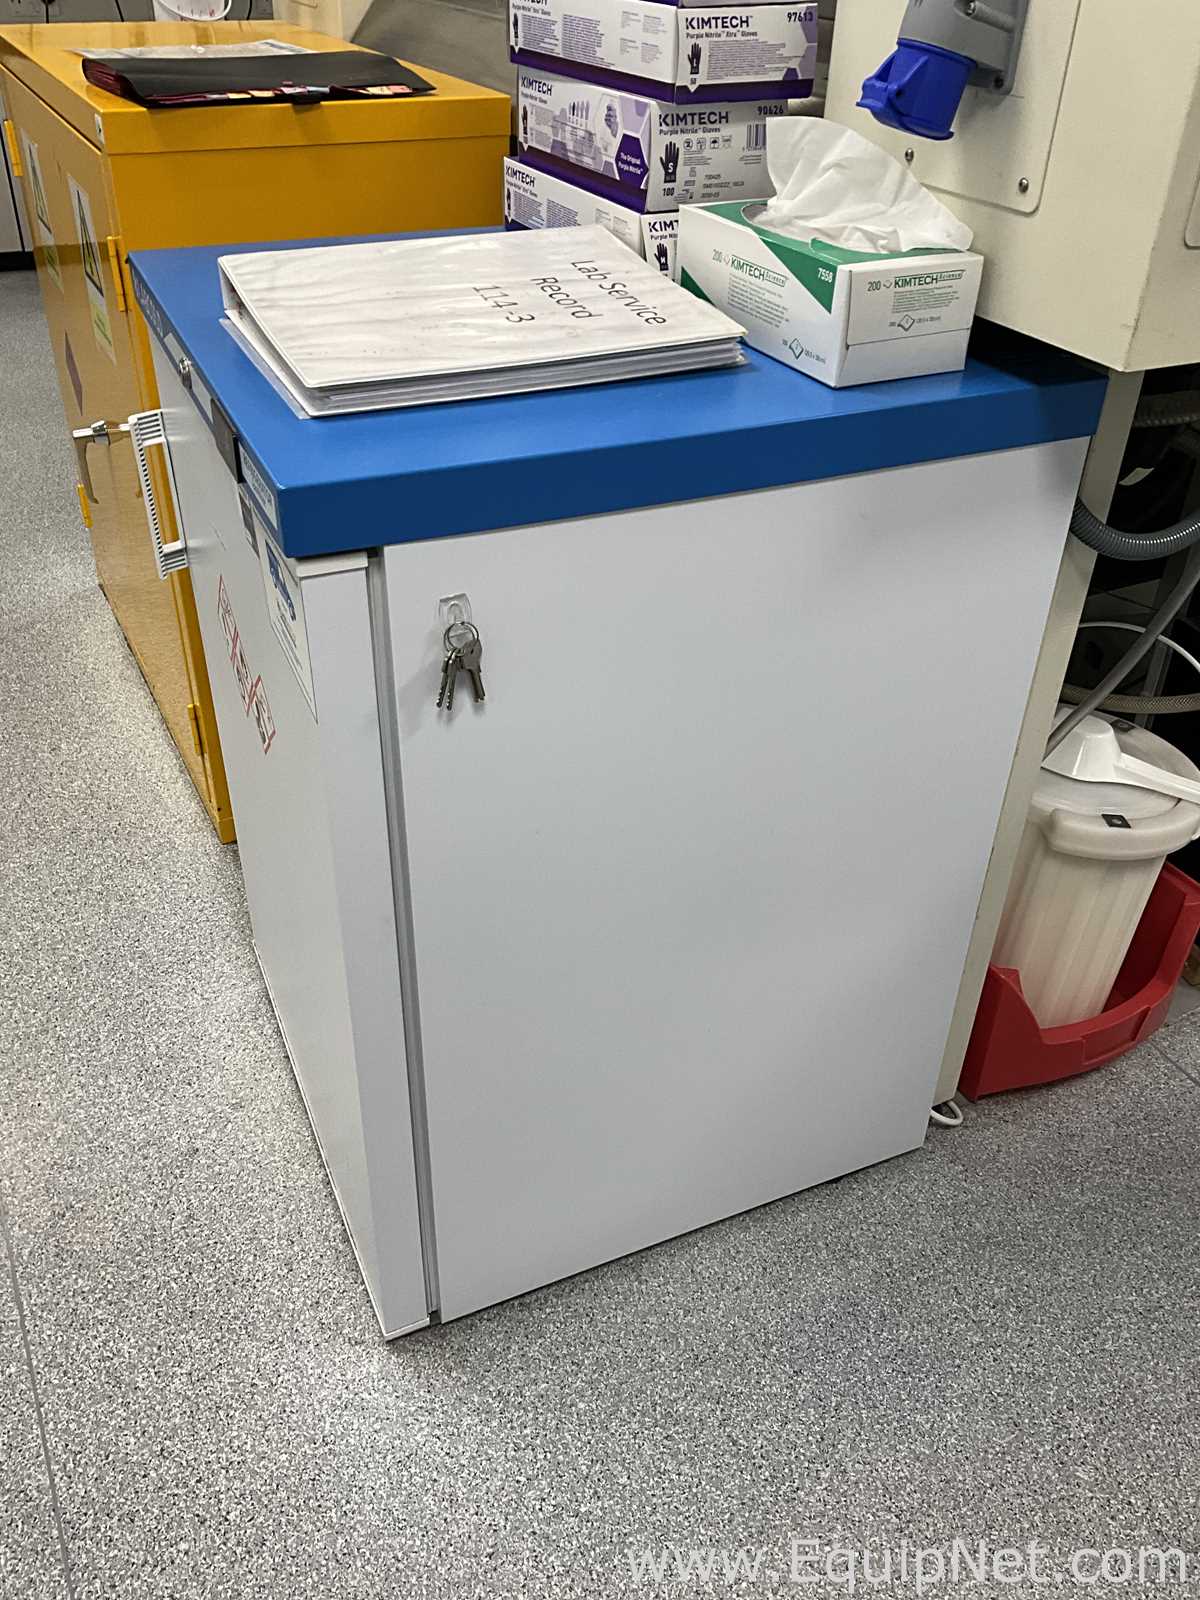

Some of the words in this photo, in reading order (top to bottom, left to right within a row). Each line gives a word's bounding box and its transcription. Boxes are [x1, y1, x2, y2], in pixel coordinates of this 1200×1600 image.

[686, 15, 750, 30] KIMTECH
[521, 76, 553, 96] KIMTECH
[659, 111, 729, 127] KIMTECH
[668, 162, 674, 173] S
[505, 166, 536, 187] KIMTECH
[648, 219, 679, 232] KIMT
[730, 256, 765, 282] KIMTECH
[817, 267, 834, 283] 7558
[867, 280, 882, 292] 200
[894, 275, 938, 289] KIMTECH
[531, 276, 604, 319] Record
[571, 259, 608, 282] Lab
[599, 282, 667, 326] Service
